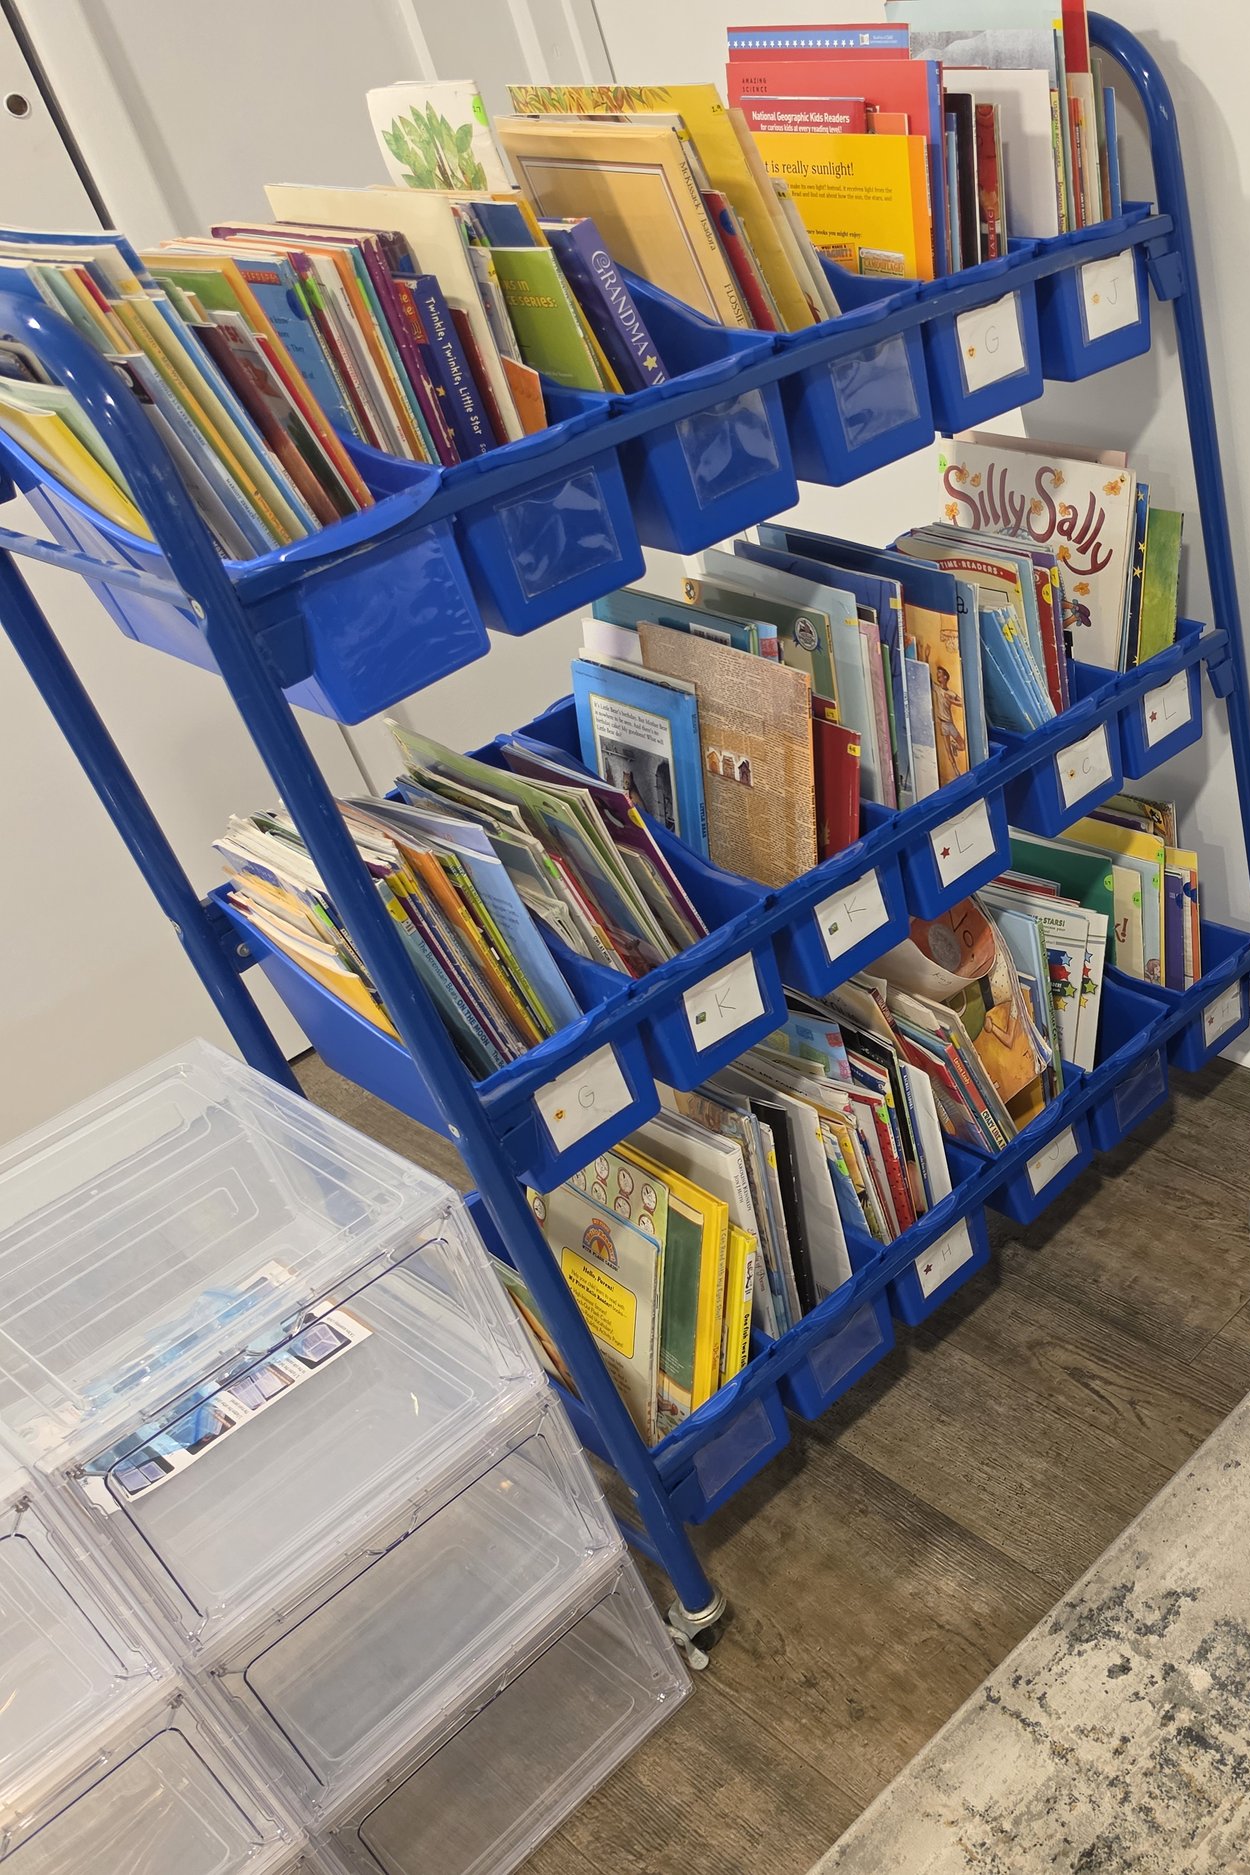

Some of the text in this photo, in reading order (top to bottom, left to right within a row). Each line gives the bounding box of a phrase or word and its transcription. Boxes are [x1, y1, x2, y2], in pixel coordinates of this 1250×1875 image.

[752, 111, 850, 124] National Geographic Kids Readers
[784, 124, 794, 132] kids
[772, 161, 780, 173] is
[782, 161, 809, 177] really
[812, 162, 855, 179] sunlight!
[680, 161, 701, 210] McKissack
[701, 218, 716, 251] Isadora
[592, 251, 649, 357] GRANDMA
[985, 325, 1000, 354] G
[425, 297, 482, 436] Twinkle, Twinkle, Little Star
[943, 463, 1025, 537] Silly
[1026, 466, 1113, 575] Sally
[962, 562, 998, 575] READERS
[1082, 757, 1093, 776] C
[954, 830, 974, 854] L
[843, 896, 868, 922] K
[1043, 917, 1066, 927] STARS!
[418, 940, 490, 1047] The Berenstain Bears ON THE MOON
[714, 987, 737, 1018] K
[577, 1086, 595, 1108] G
[981, 1110, 995, 1128] CRAZY
[991, 1125, 1003, 1143] LIKE
[737, 1158, 752, 1211] CAROLINE KENNEDY
[582, 1244, 592, 1254] WITH
[592, 1251, 605, 1263] FLASH
[582, 1265, 597, 1281] Hello,
[758, 1269, 766, 1292] Poems
[575, 1279, 586, 1291] First
[586, 1286, 597, 1299] Hello
[741, 1341, 749, 1355] two
